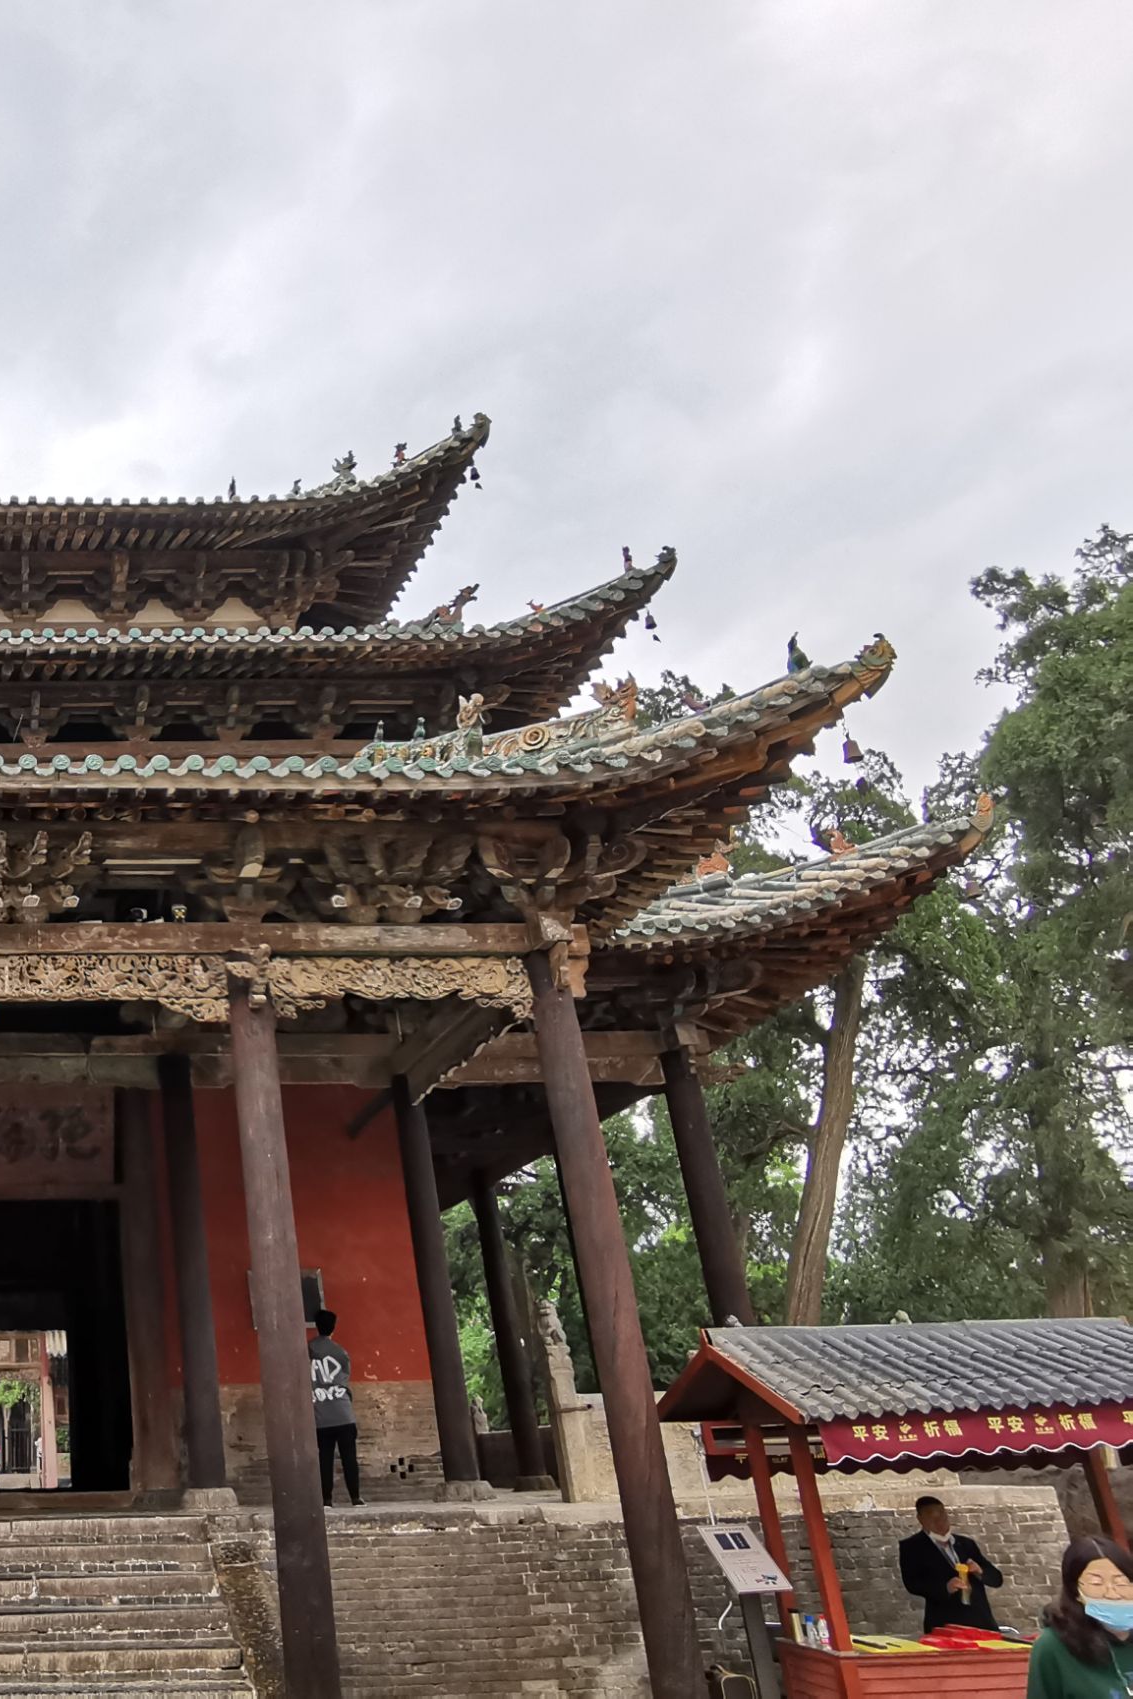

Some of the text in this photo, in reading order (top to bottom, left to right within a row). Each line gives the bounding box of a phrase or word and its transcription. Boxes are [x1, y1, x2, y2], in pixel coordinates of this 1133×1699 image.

[852, 1424, 890, 1442] 平安
[923, 1419, 963, 1438] 祈福
[987, 1415, 1026, 1434] 平安
[1058, 1412, 1097, 1432] 祈福
